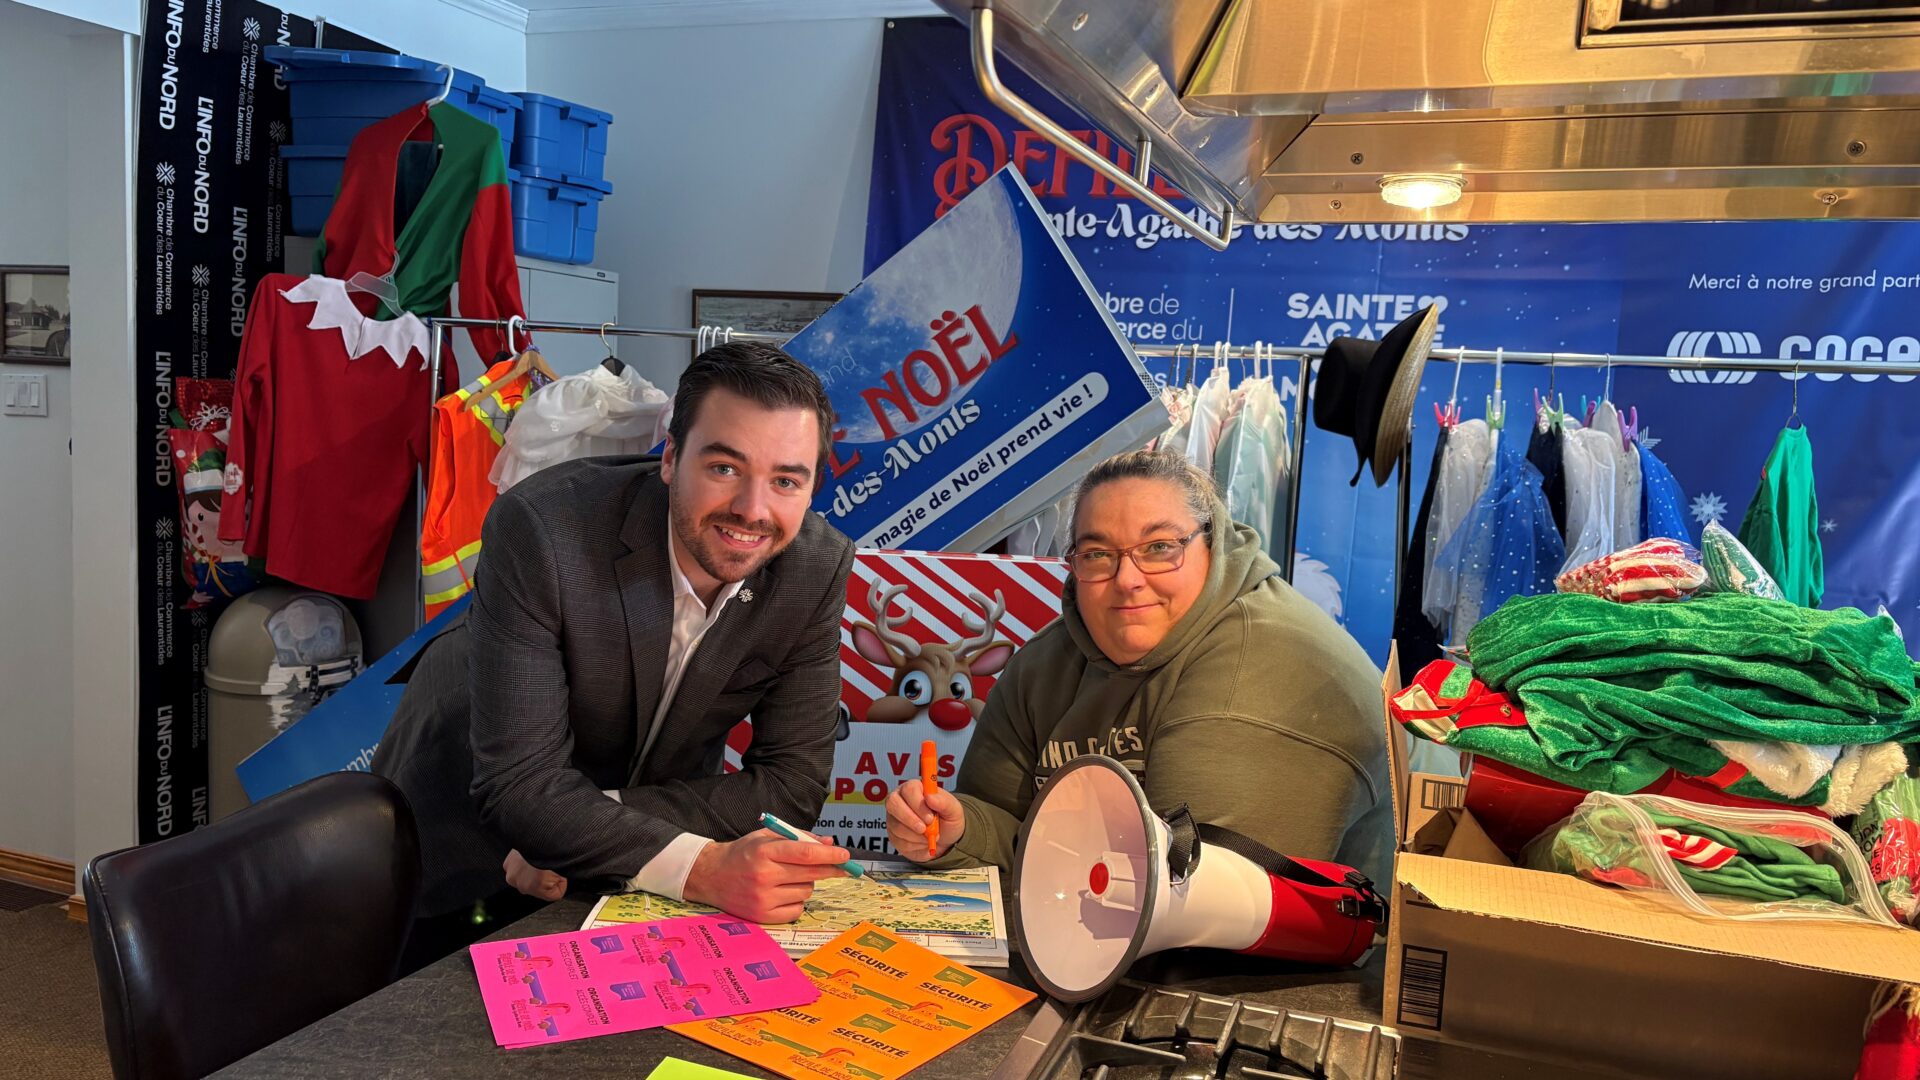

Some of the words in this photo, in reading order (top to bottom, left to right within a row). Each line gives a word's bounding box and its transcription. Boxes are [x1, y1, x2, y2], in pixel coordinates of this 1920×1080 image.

[239, 55, 249, 88] Coeur
[249, 43, 259, 90] Chambre
[159, 63, 179, 130] NORD
[235, 106, 246, 165] Laurentides
[244, 105, 254, 161] Commerce
[156, 201, 165, 234] Coeur
[165, 188, 175, 236] Chambre
[193, 170, 211, 234] NORD
[156, 254, 165, 315] Laurentides
[164, 252, 174, 310] Commerce
[1100, 291, 1145, 315] bre
[1148, 292, 1180, 315] de
[1688, 273, 1741, 289] Merci
[1747, 273, 1760, 289] à
[1766, 275, 1813, 289] notre
[1819, 269, 1877, 293] grand
[192, 302, 201, 334] Coeur
[201, 289, 210, 336] Chambre
[230, 276, 246, 337] NORD
[1171, 318, 1203, 341] du
[1286, 292, 1415, 321] SAINTE
[859, 303, 1019, 441] NOËL
[155, 424, 172, 487] NORD
[874, 506, 926, 549] magie
[929, 489, 952, 511] de
[952, 452, 996, 493] Noël
[997, 413, 1053, 465] prend
[1053, 395, 1083, 420] vie
[157, 556, 165, 587] Coeur
[165, 541, 174, 587] Chambre
[157, 607, 166, 666] Laurentides
[165, 602, 174, 658] Commerce
[156, 775, 172, 836] NORD
[838, 816, 853, 828] de
[569, 941, 591, 979] ORGANISATION
[697, 924, 724, 959] ORGANISATION
[840, 946, 909, 980] SÉCURITÉ
[588, 987, 610, 1025] ORGANISATION
[723, 967, 752, 1005] ORGANISATION
[920, 981, 994, 1011] SÉCURITÉ
[833, 1026, 911, 1058] SÉCURITÉ
